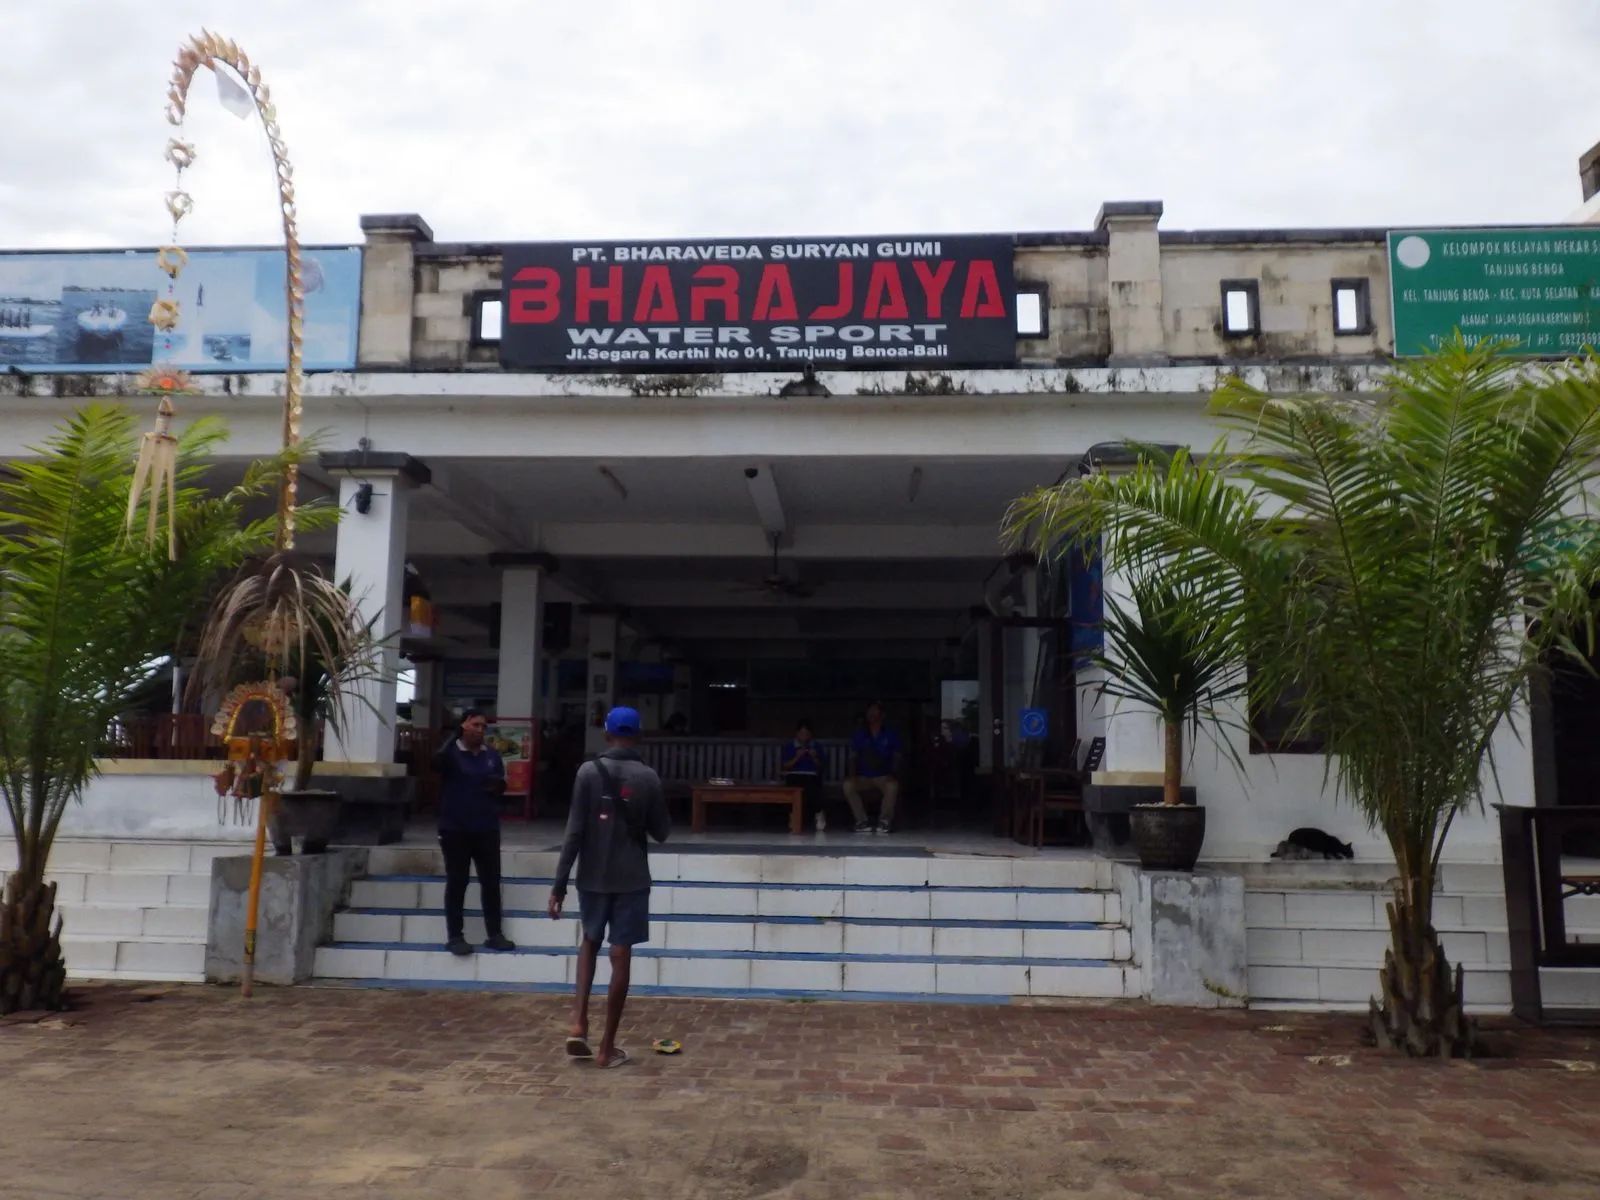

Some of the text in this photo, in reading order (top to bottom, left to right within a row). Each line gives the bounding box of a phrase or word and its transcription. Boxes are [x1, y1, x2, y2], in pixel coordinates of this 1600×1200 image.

[572, 241, 942, 262] PT. BHARAVEDA SURYAN GUMI
[1442, 241, 1500, 256] KELOMPOK
[1503, 240, 1551, 254] NELAYAN
[1554, 239, 1590, 254] MEKAR
[1483, 262, 1564, 277] TANJUNG BENOA
[509, 259, 1006, 324] BHARA JAYA
[1423, 288, 1460, 302] TANJUNG
[1462, 287, 1490, 301] BENOA
[1521, 287, 1542, 301] KUTA
[1544, 286, 1579, 300] SELATAN
[566, 324, 948, 345] WATER SPORT
[566, 344, 948, 361] Jl.Segara Kerthi No 01, Tanjung Benoa-Bali
